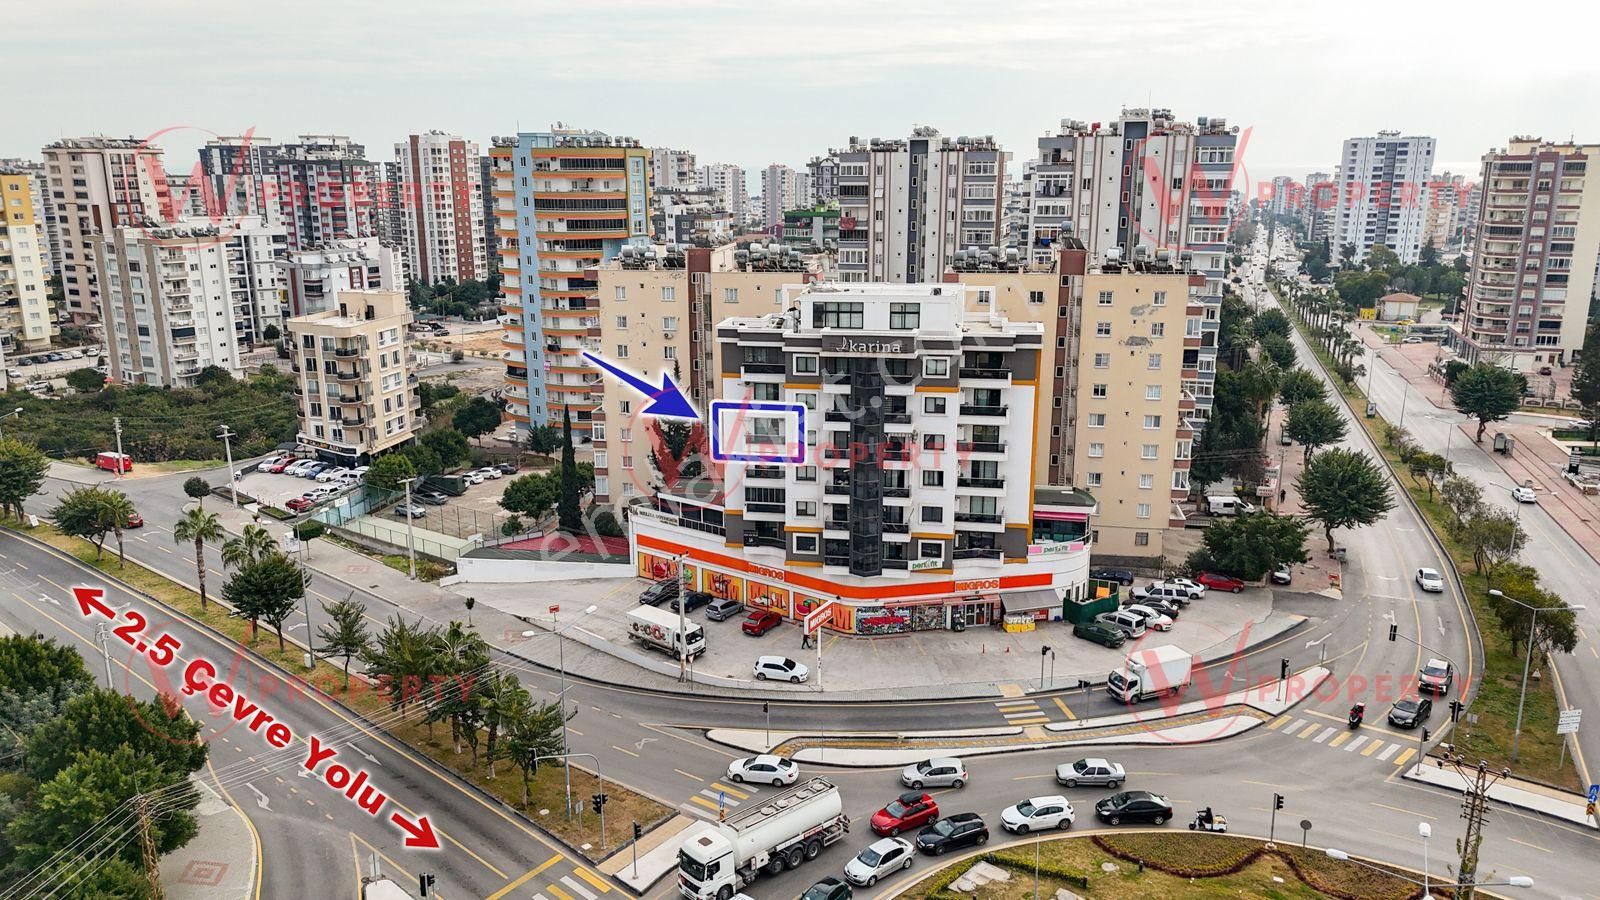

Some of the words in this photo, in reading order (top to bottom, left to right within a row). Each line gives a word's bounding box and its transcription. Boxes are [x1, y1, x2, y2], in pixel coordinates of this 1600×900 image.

[748, 564, 784, 580] MIGROS
[956, 579, 999, 591] MIGROS
[810, 607, 832, 630] MIGROS
